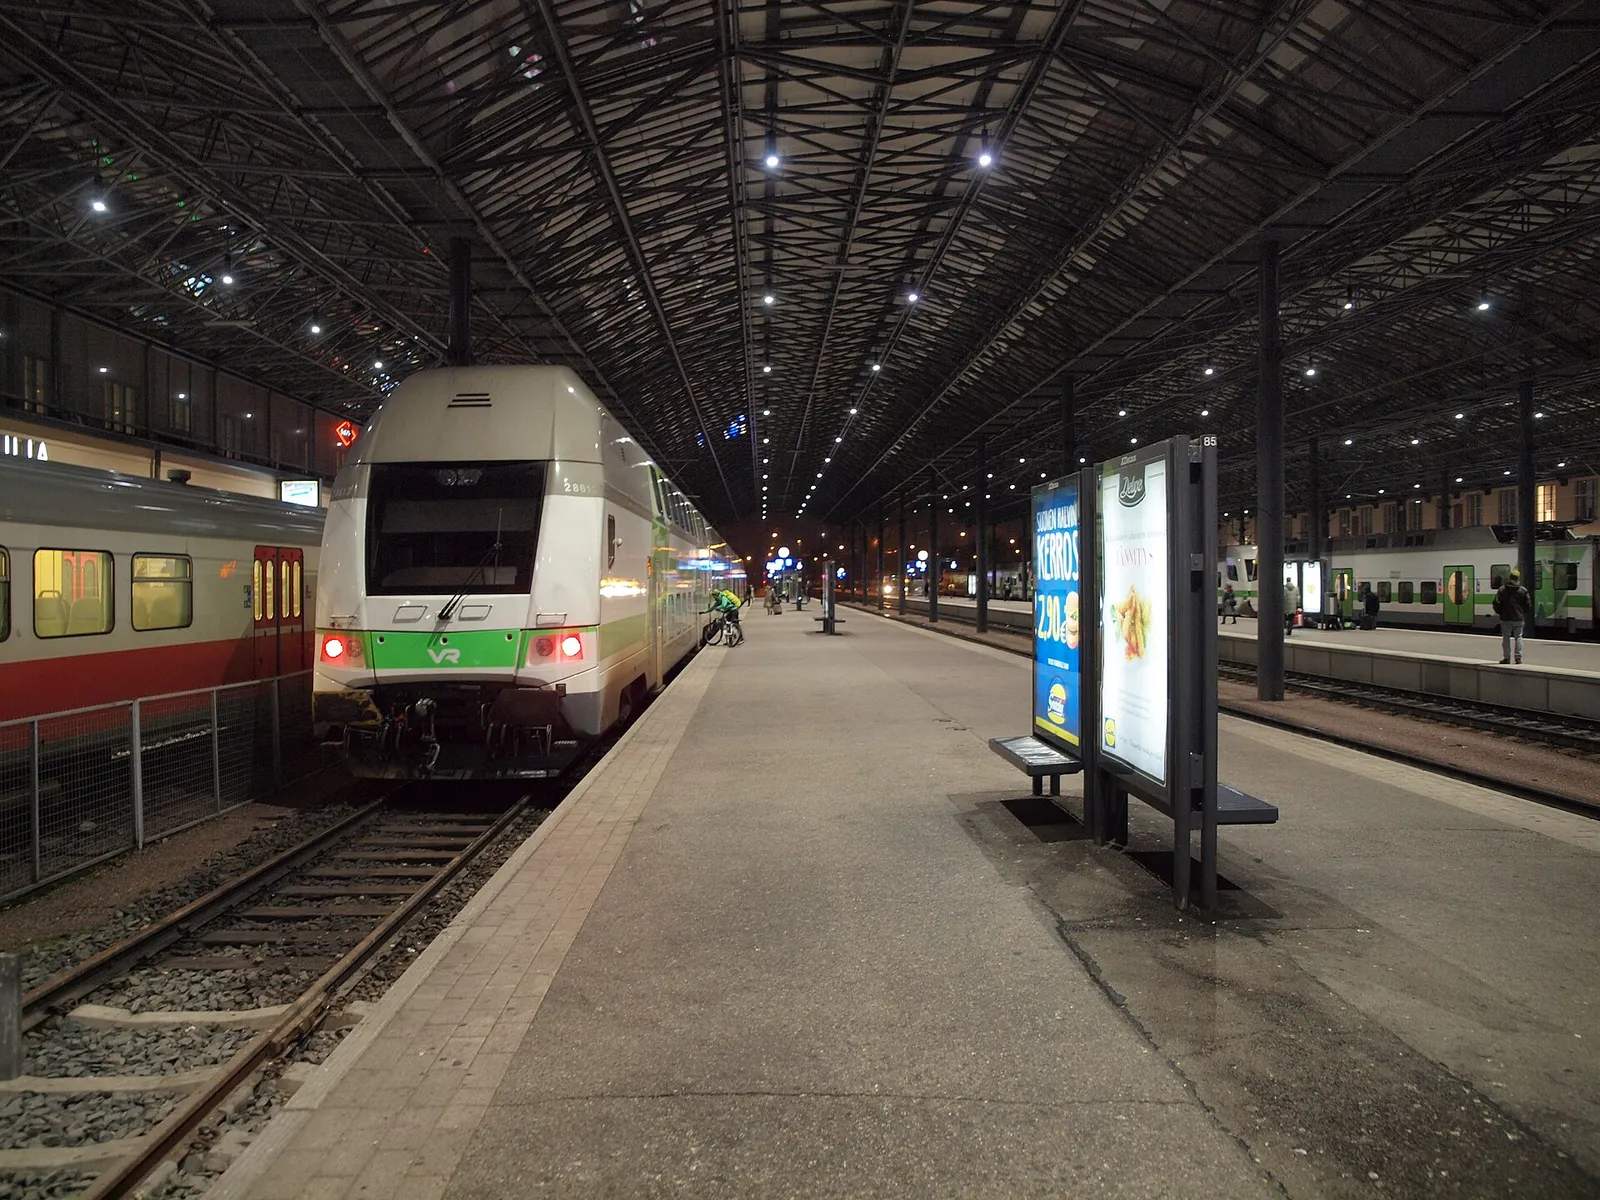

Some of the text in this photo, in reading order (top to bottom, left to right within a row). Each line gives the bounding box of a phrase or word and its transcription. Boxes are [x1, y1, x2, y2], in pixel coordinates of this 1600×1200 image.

[1204, 436, 1217, 446] 85
[1037, 530, 1079, 581] KERROS
[427, 648, 460, 664] VR
